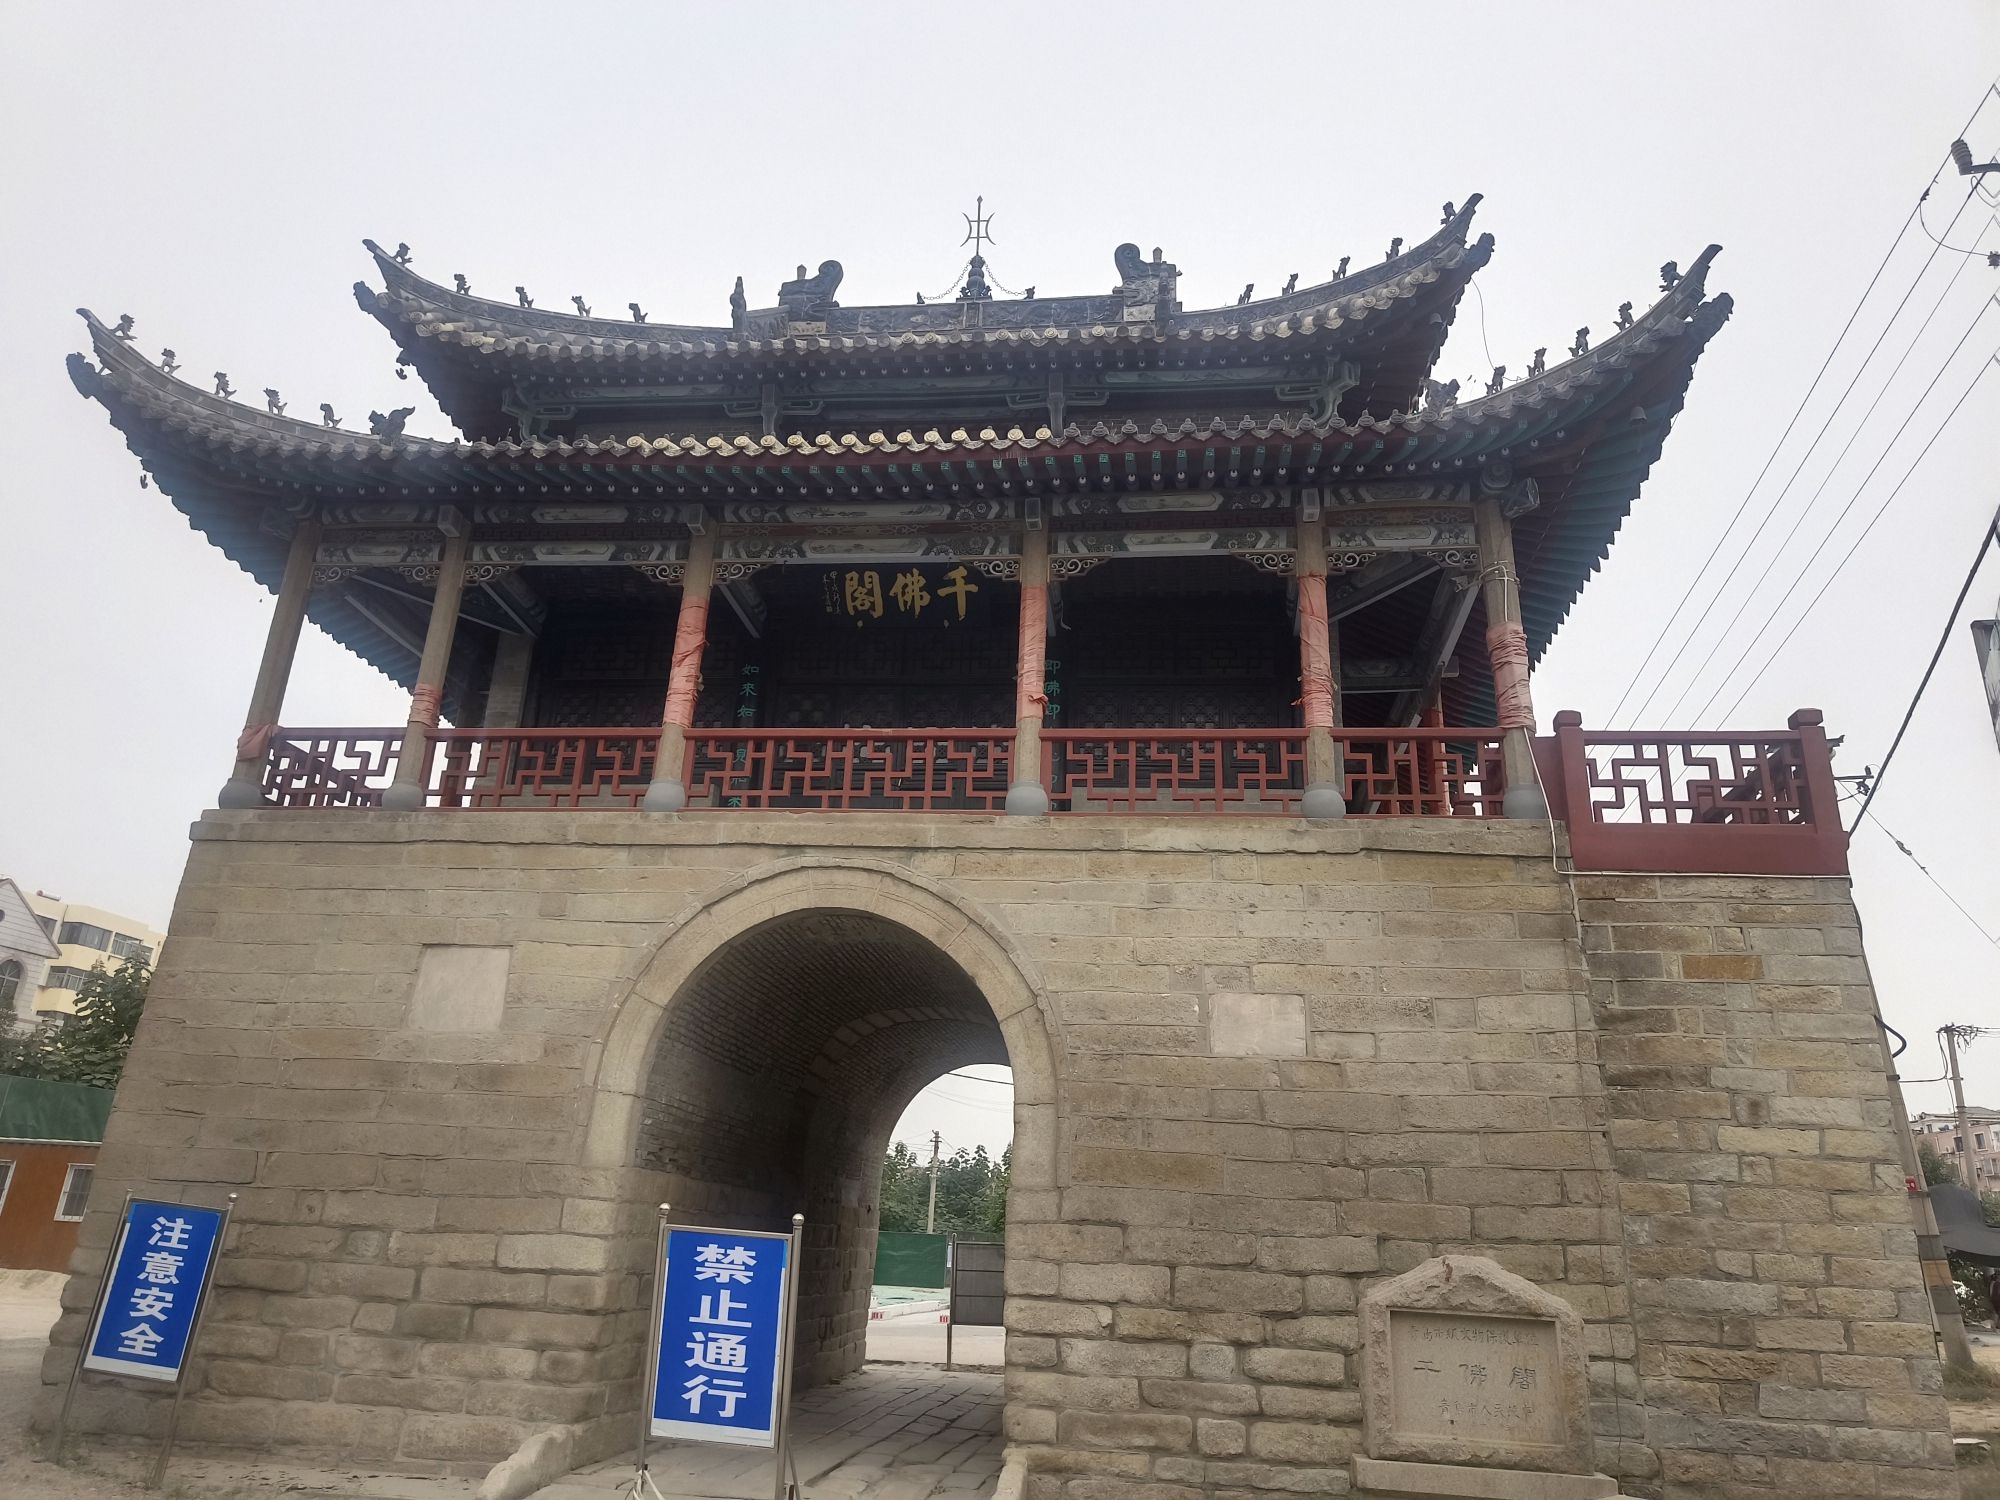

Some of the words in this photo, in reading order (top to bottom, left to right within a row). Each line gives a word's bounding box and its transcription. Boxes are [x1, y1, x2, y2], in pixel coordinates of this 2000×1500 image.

[118, 1215, 192, 1358] 注意安全
[680, 1243, 758, 1418] 禁止通行
